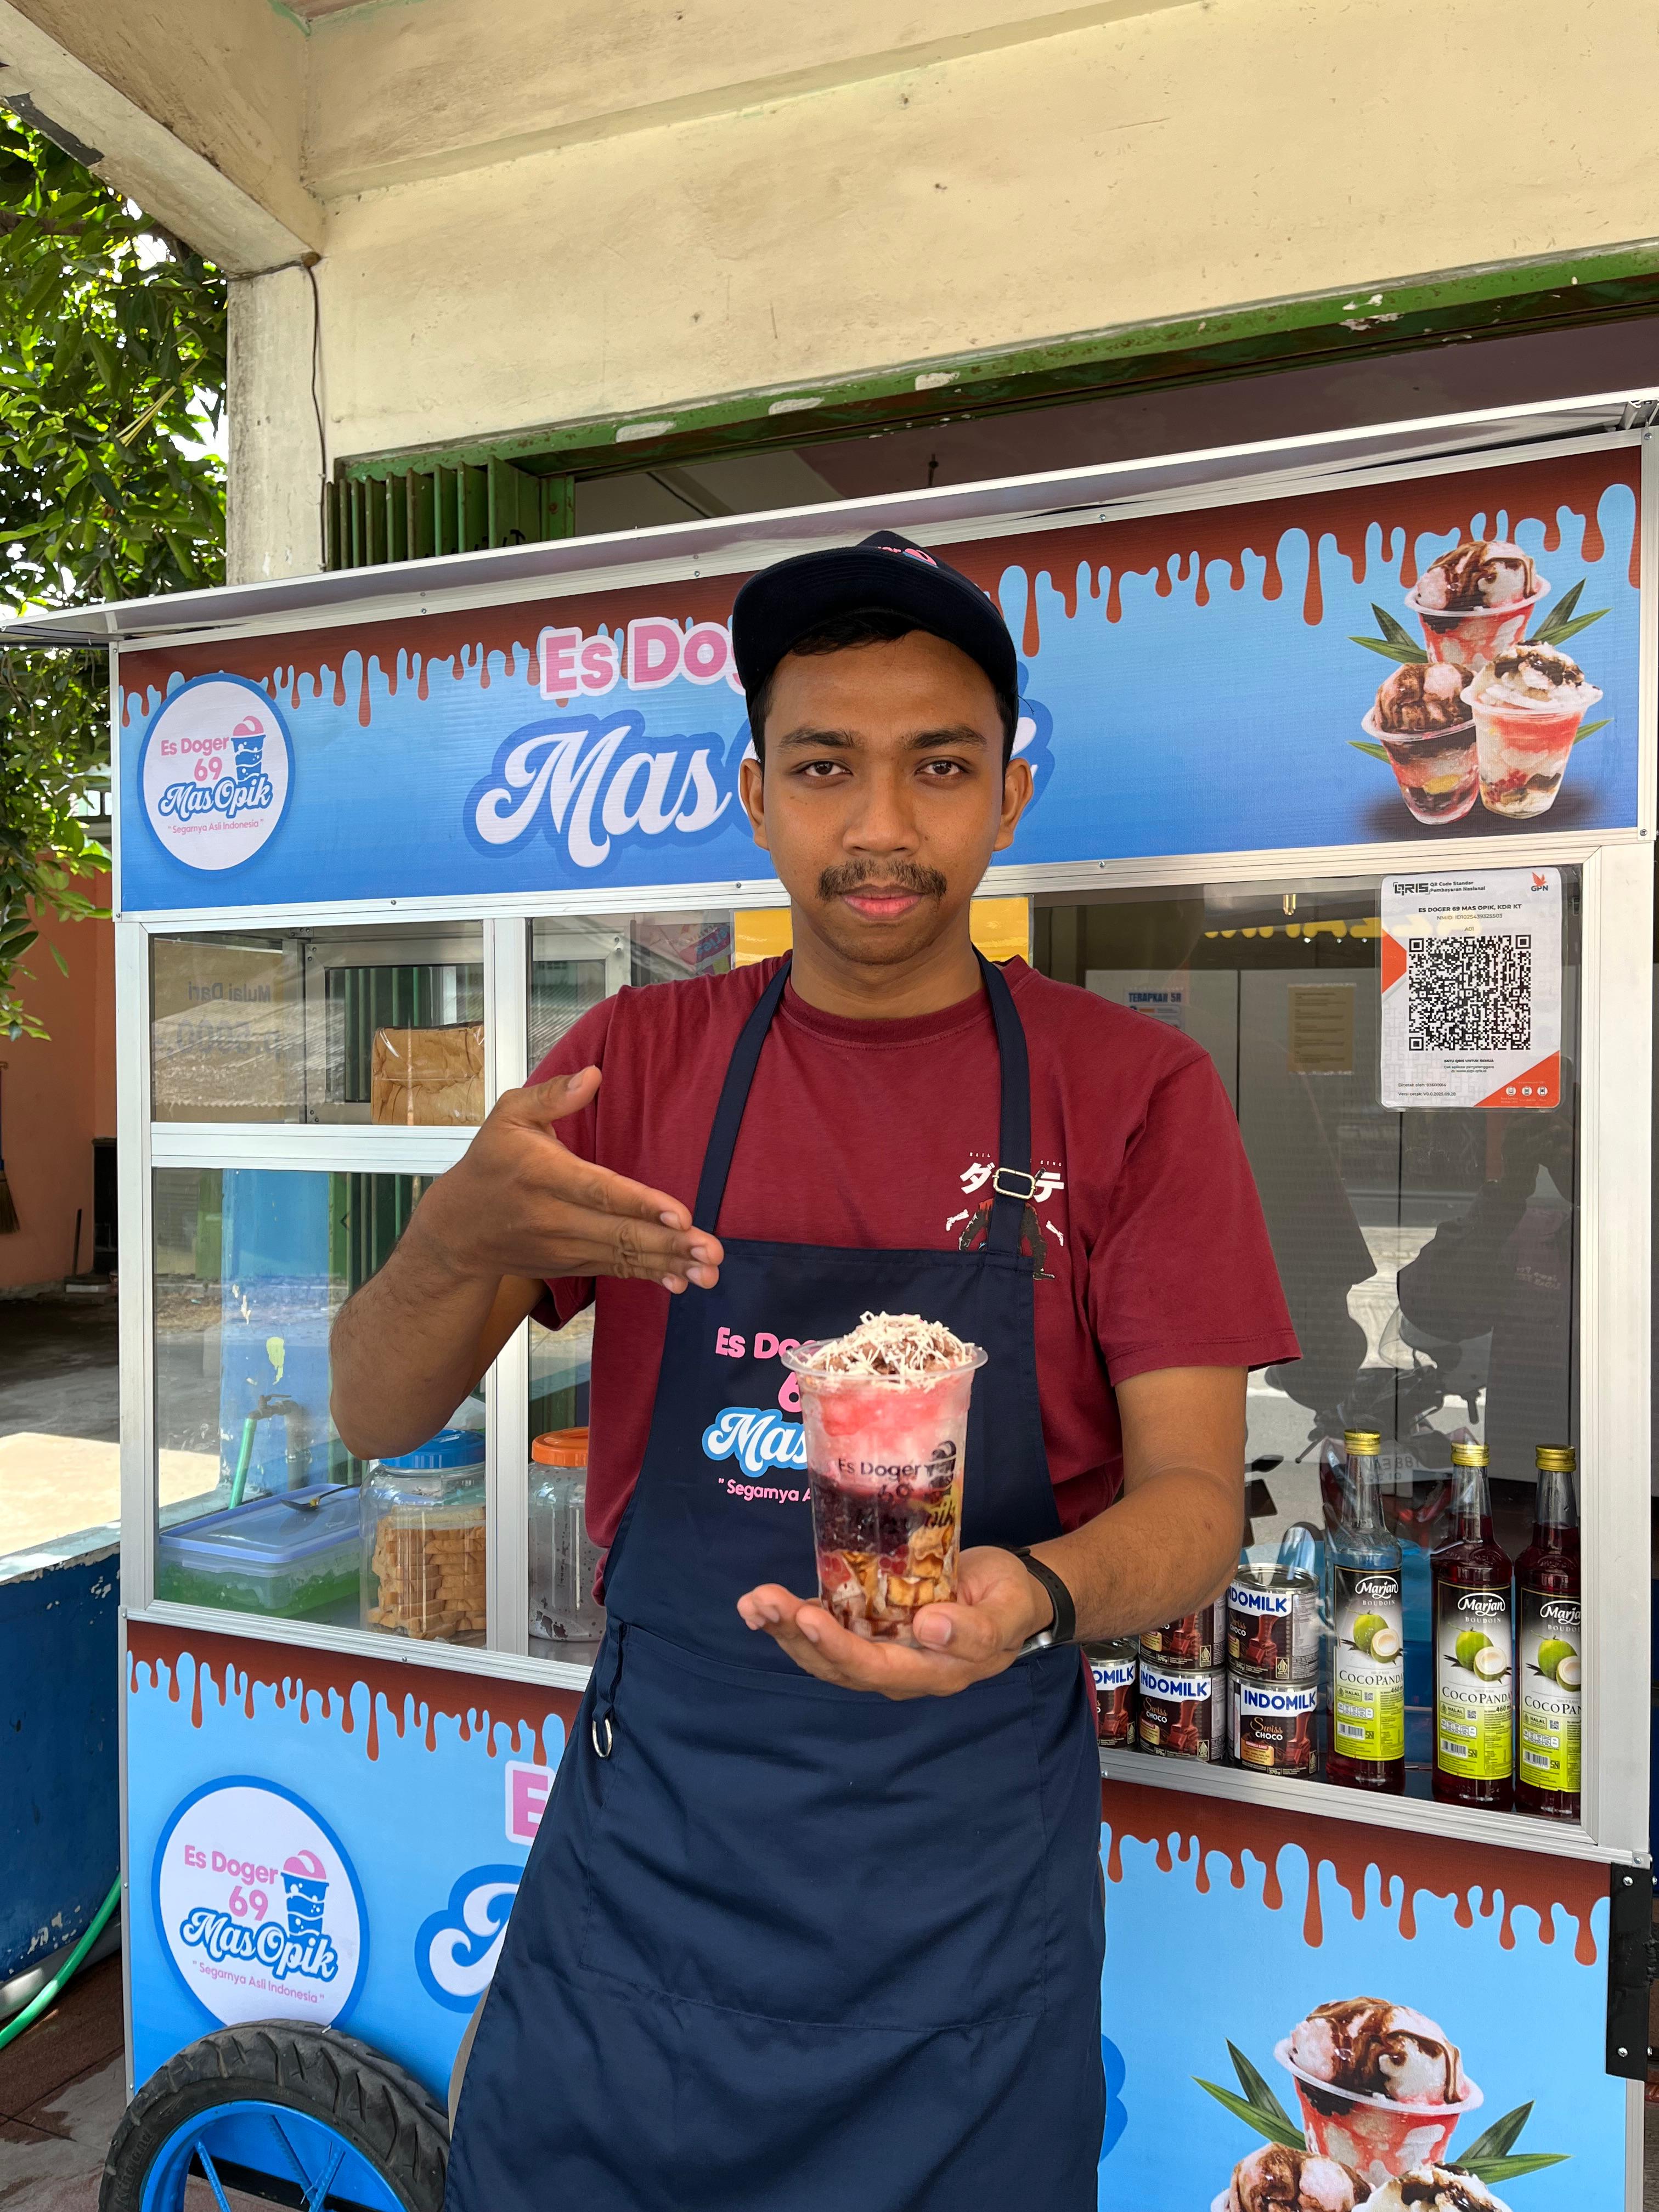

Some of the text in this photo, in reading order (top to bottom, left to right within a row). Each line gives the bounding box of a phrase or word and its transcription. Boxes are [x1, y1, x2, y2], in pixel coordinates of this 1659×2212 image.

[543, 622, 746, 696] Es Do
[161, 736, 229, 756] Es Doger
[194, 757, 223, 782] 69
[476, 726, 732, 868] Mas
[208, 822, 222, 831] Asli
[223, 819, 259, 829] Indonesia
[1394, 883, 1429, 896] QRIS
[715, 1327, 746, 1358] Es
[778, 1372, 804, 1413] 6
[861, 1460, 922, 1482] Doger
[1355, 1576, 1399, 1599] Marjan
[1458, 1593, 1505, 1617] Marjan
[1540, 1600, 1581, 1626] Marja
[1141, 1672, 1207, 1697] INDOMILK
[1244, 1689, 1316, 1711] INDOMILK
[1146, 1711, 1167, 1723] CHOCO
[1250, 1717, 1284, 1734] Swiss
[1255, 1731, 1283, 1741] CHOCO
[184, 1844, 278, 1886] Es Doger
[229, 1886, 268, 1921] 69
[249, 1976, 267, 1990] Asli
[268, 1980, 318, 2003] Indonesia
